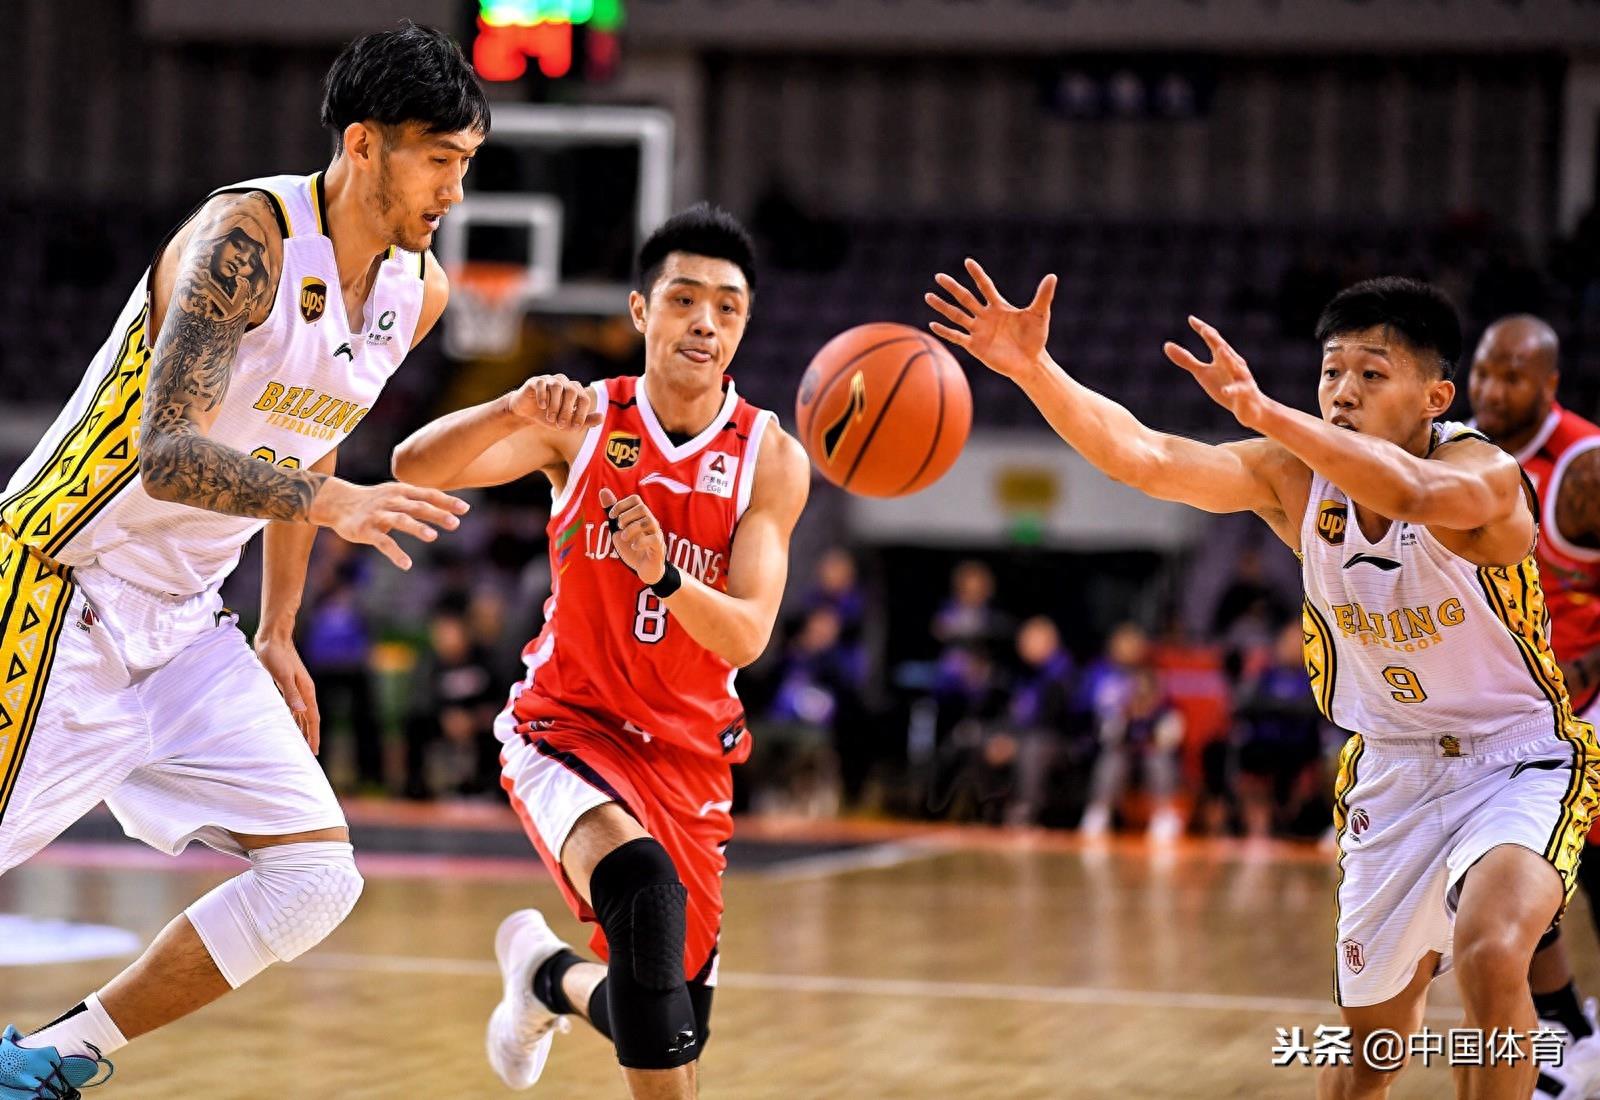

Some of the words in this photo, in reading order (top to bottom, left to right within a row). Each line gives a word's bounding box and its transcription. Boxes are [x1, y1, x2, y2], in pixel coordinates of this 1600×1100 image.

[302, 290, 324, 316] ups
[253, 381, 369, 433] BEIJING
[607, 440, 639, 464] ups
[633, 587, 668, 643] 8
[1331, 597, 1466, 643] EIJING
[1381, 665, 1428, 704] 9
